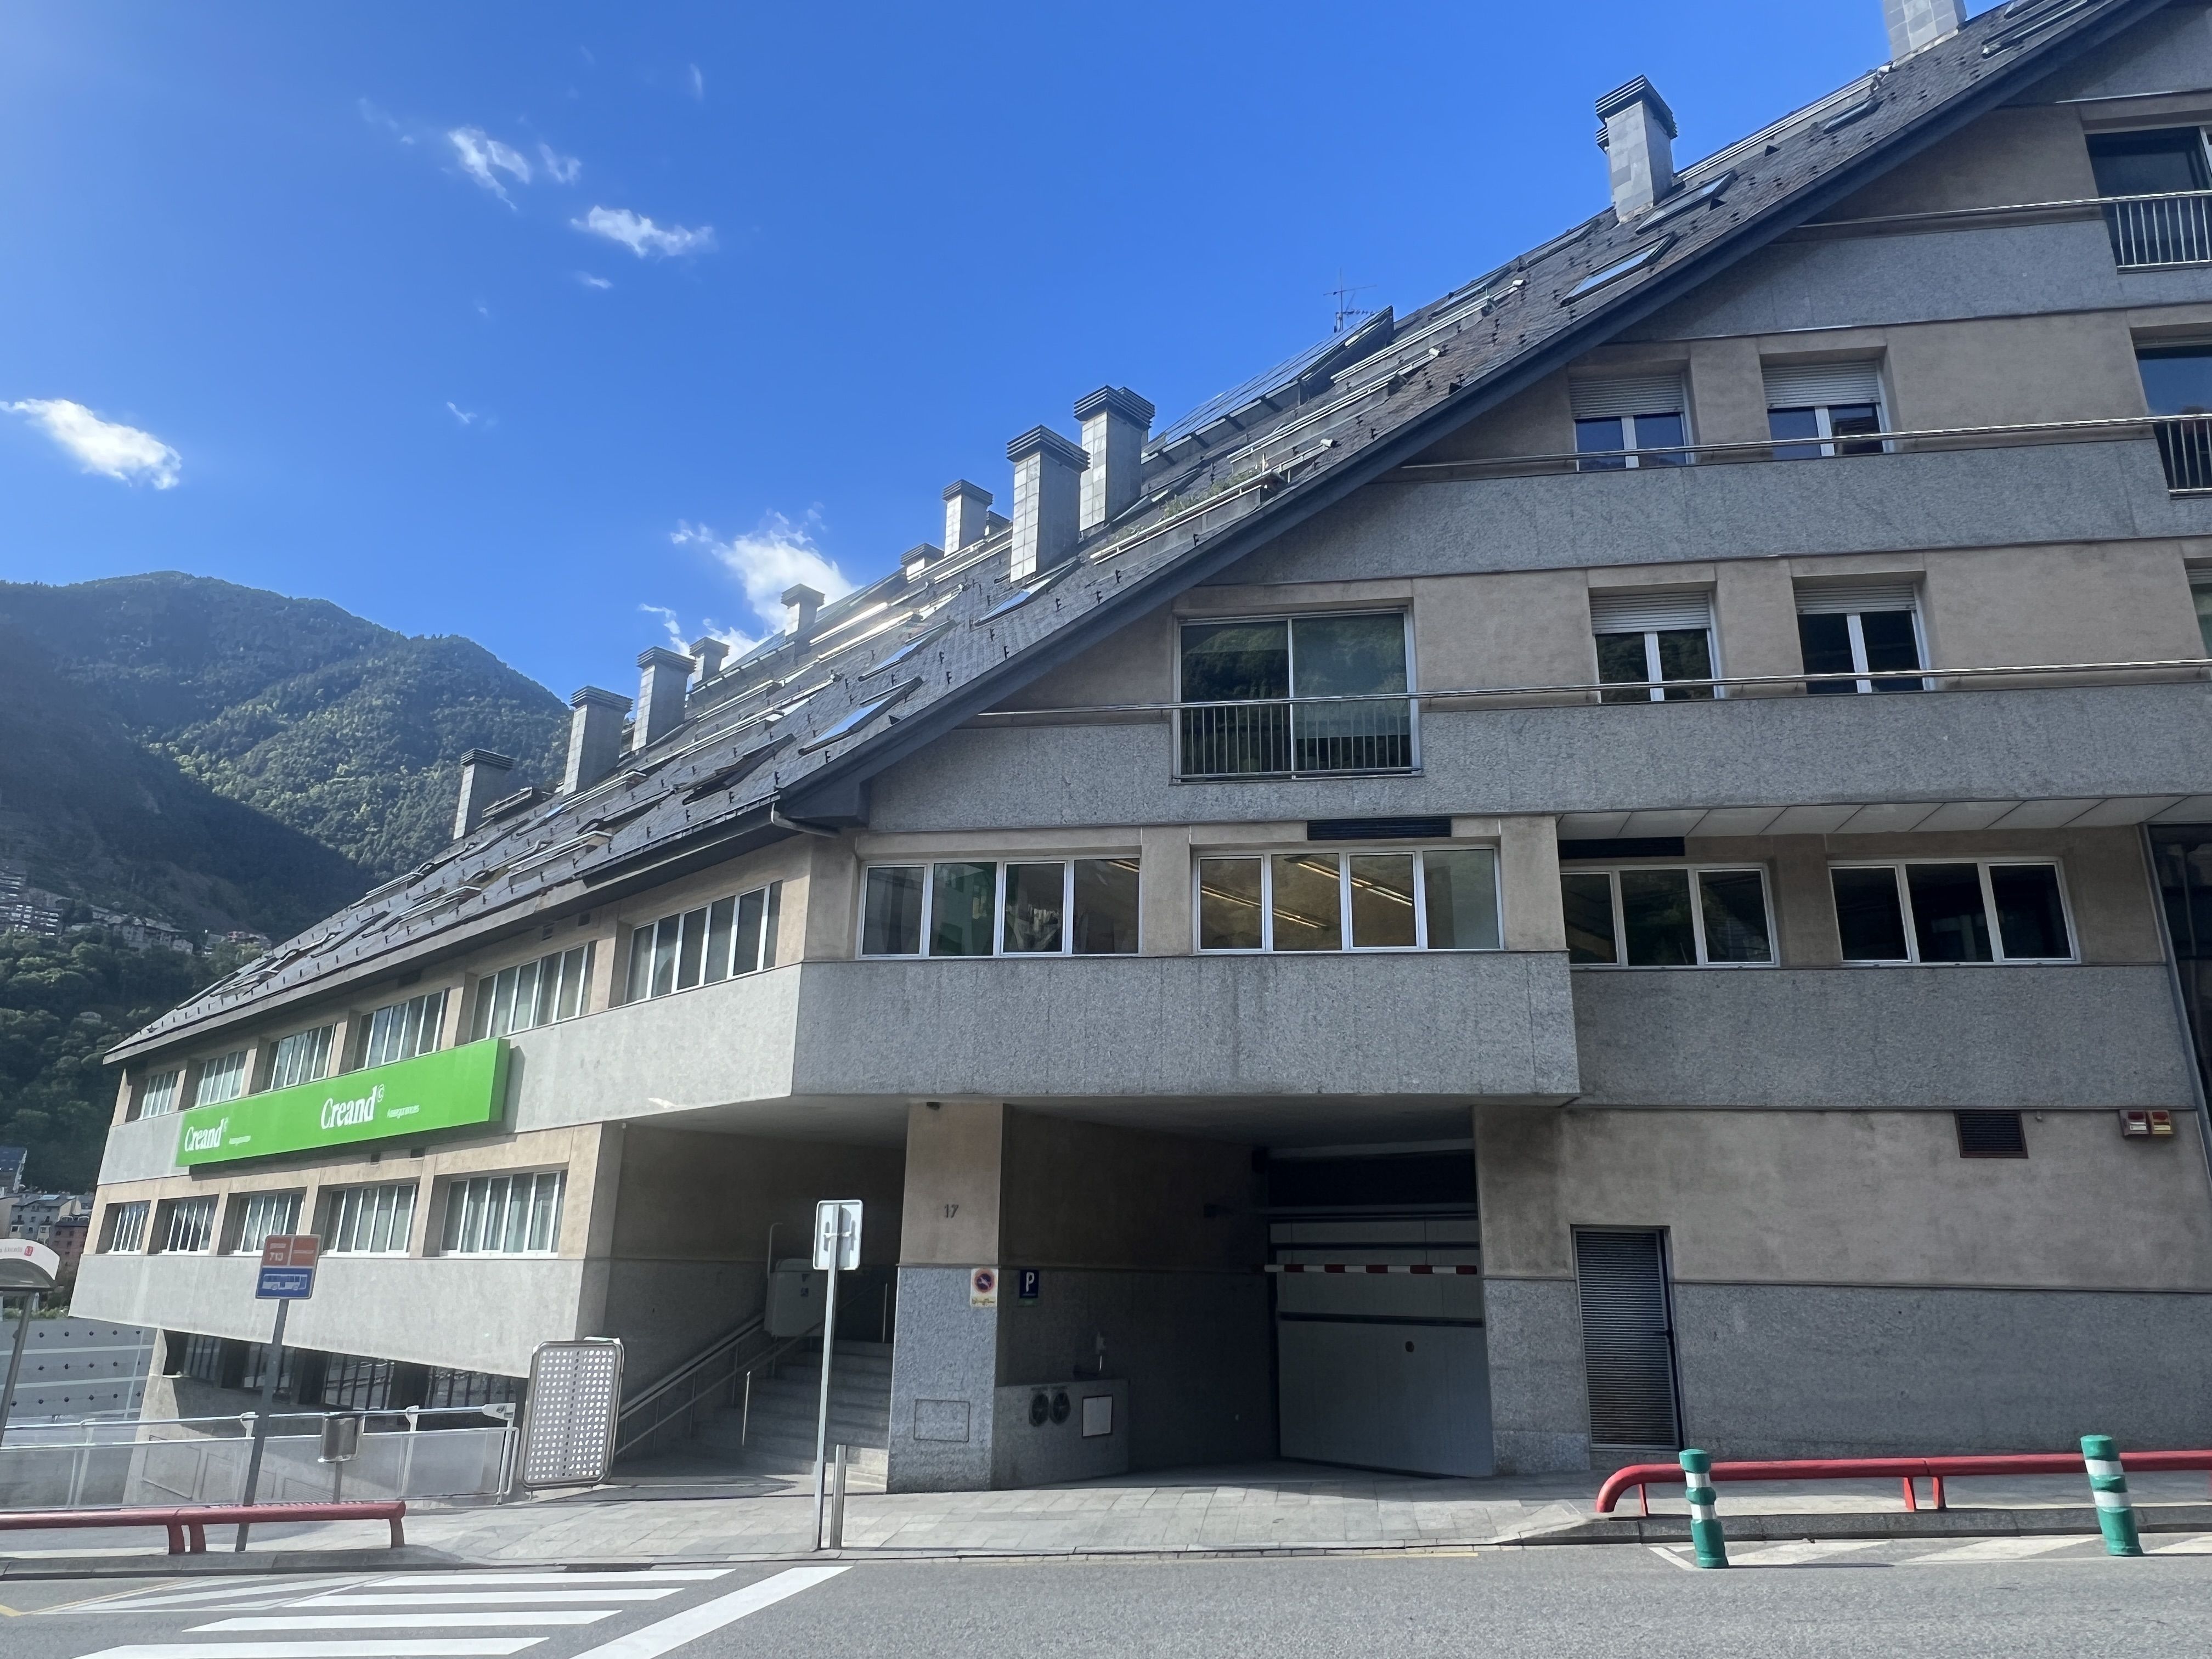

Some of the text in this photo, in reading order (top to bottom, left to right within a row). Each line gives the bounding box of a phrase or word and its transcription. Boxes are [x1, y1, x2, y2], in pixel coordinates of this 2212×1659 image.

[320, 1085, 377, 1130] Creand
[184, 1118, 225, 1152] Creand
[944, 1204, 960, 1218] 17
[1025, 1272, 1035, 1293] P
